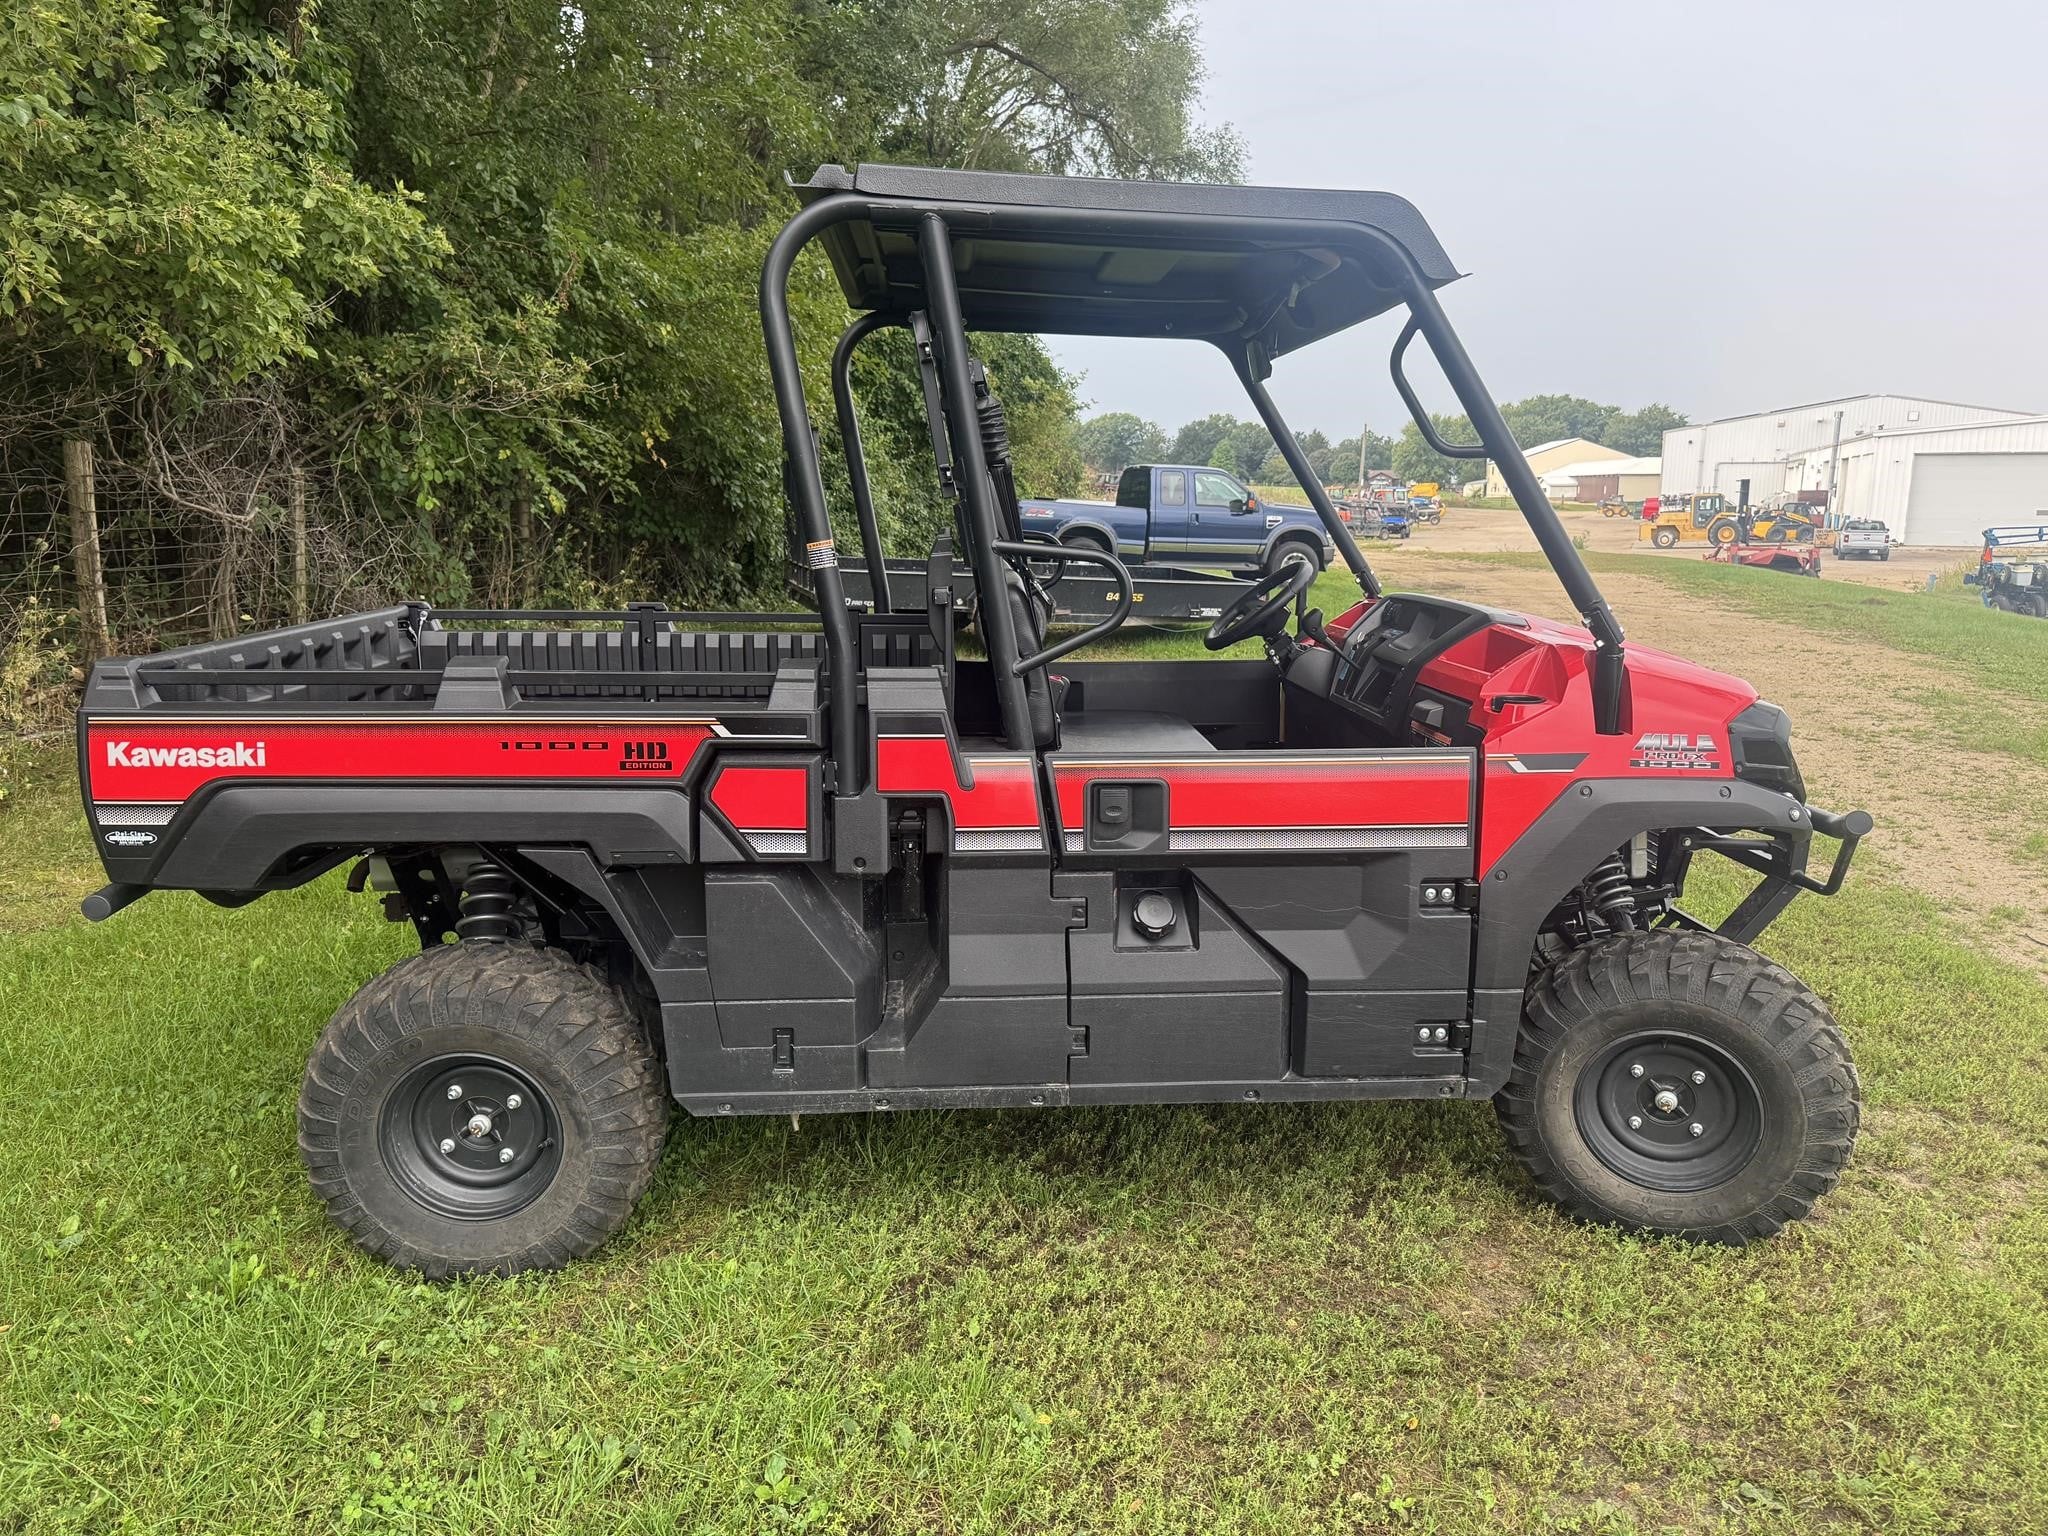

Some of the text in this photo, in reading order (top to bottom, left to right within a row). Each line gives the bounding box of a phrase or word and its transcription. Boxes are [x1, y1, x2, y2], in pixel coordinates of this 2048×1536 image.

[499, 741, 608, 750] 1000
[624, 742, 667, 759] HD
[1632, 733, 1719, 752] MULE
[106, 741, 266, 767] Kawasaki
